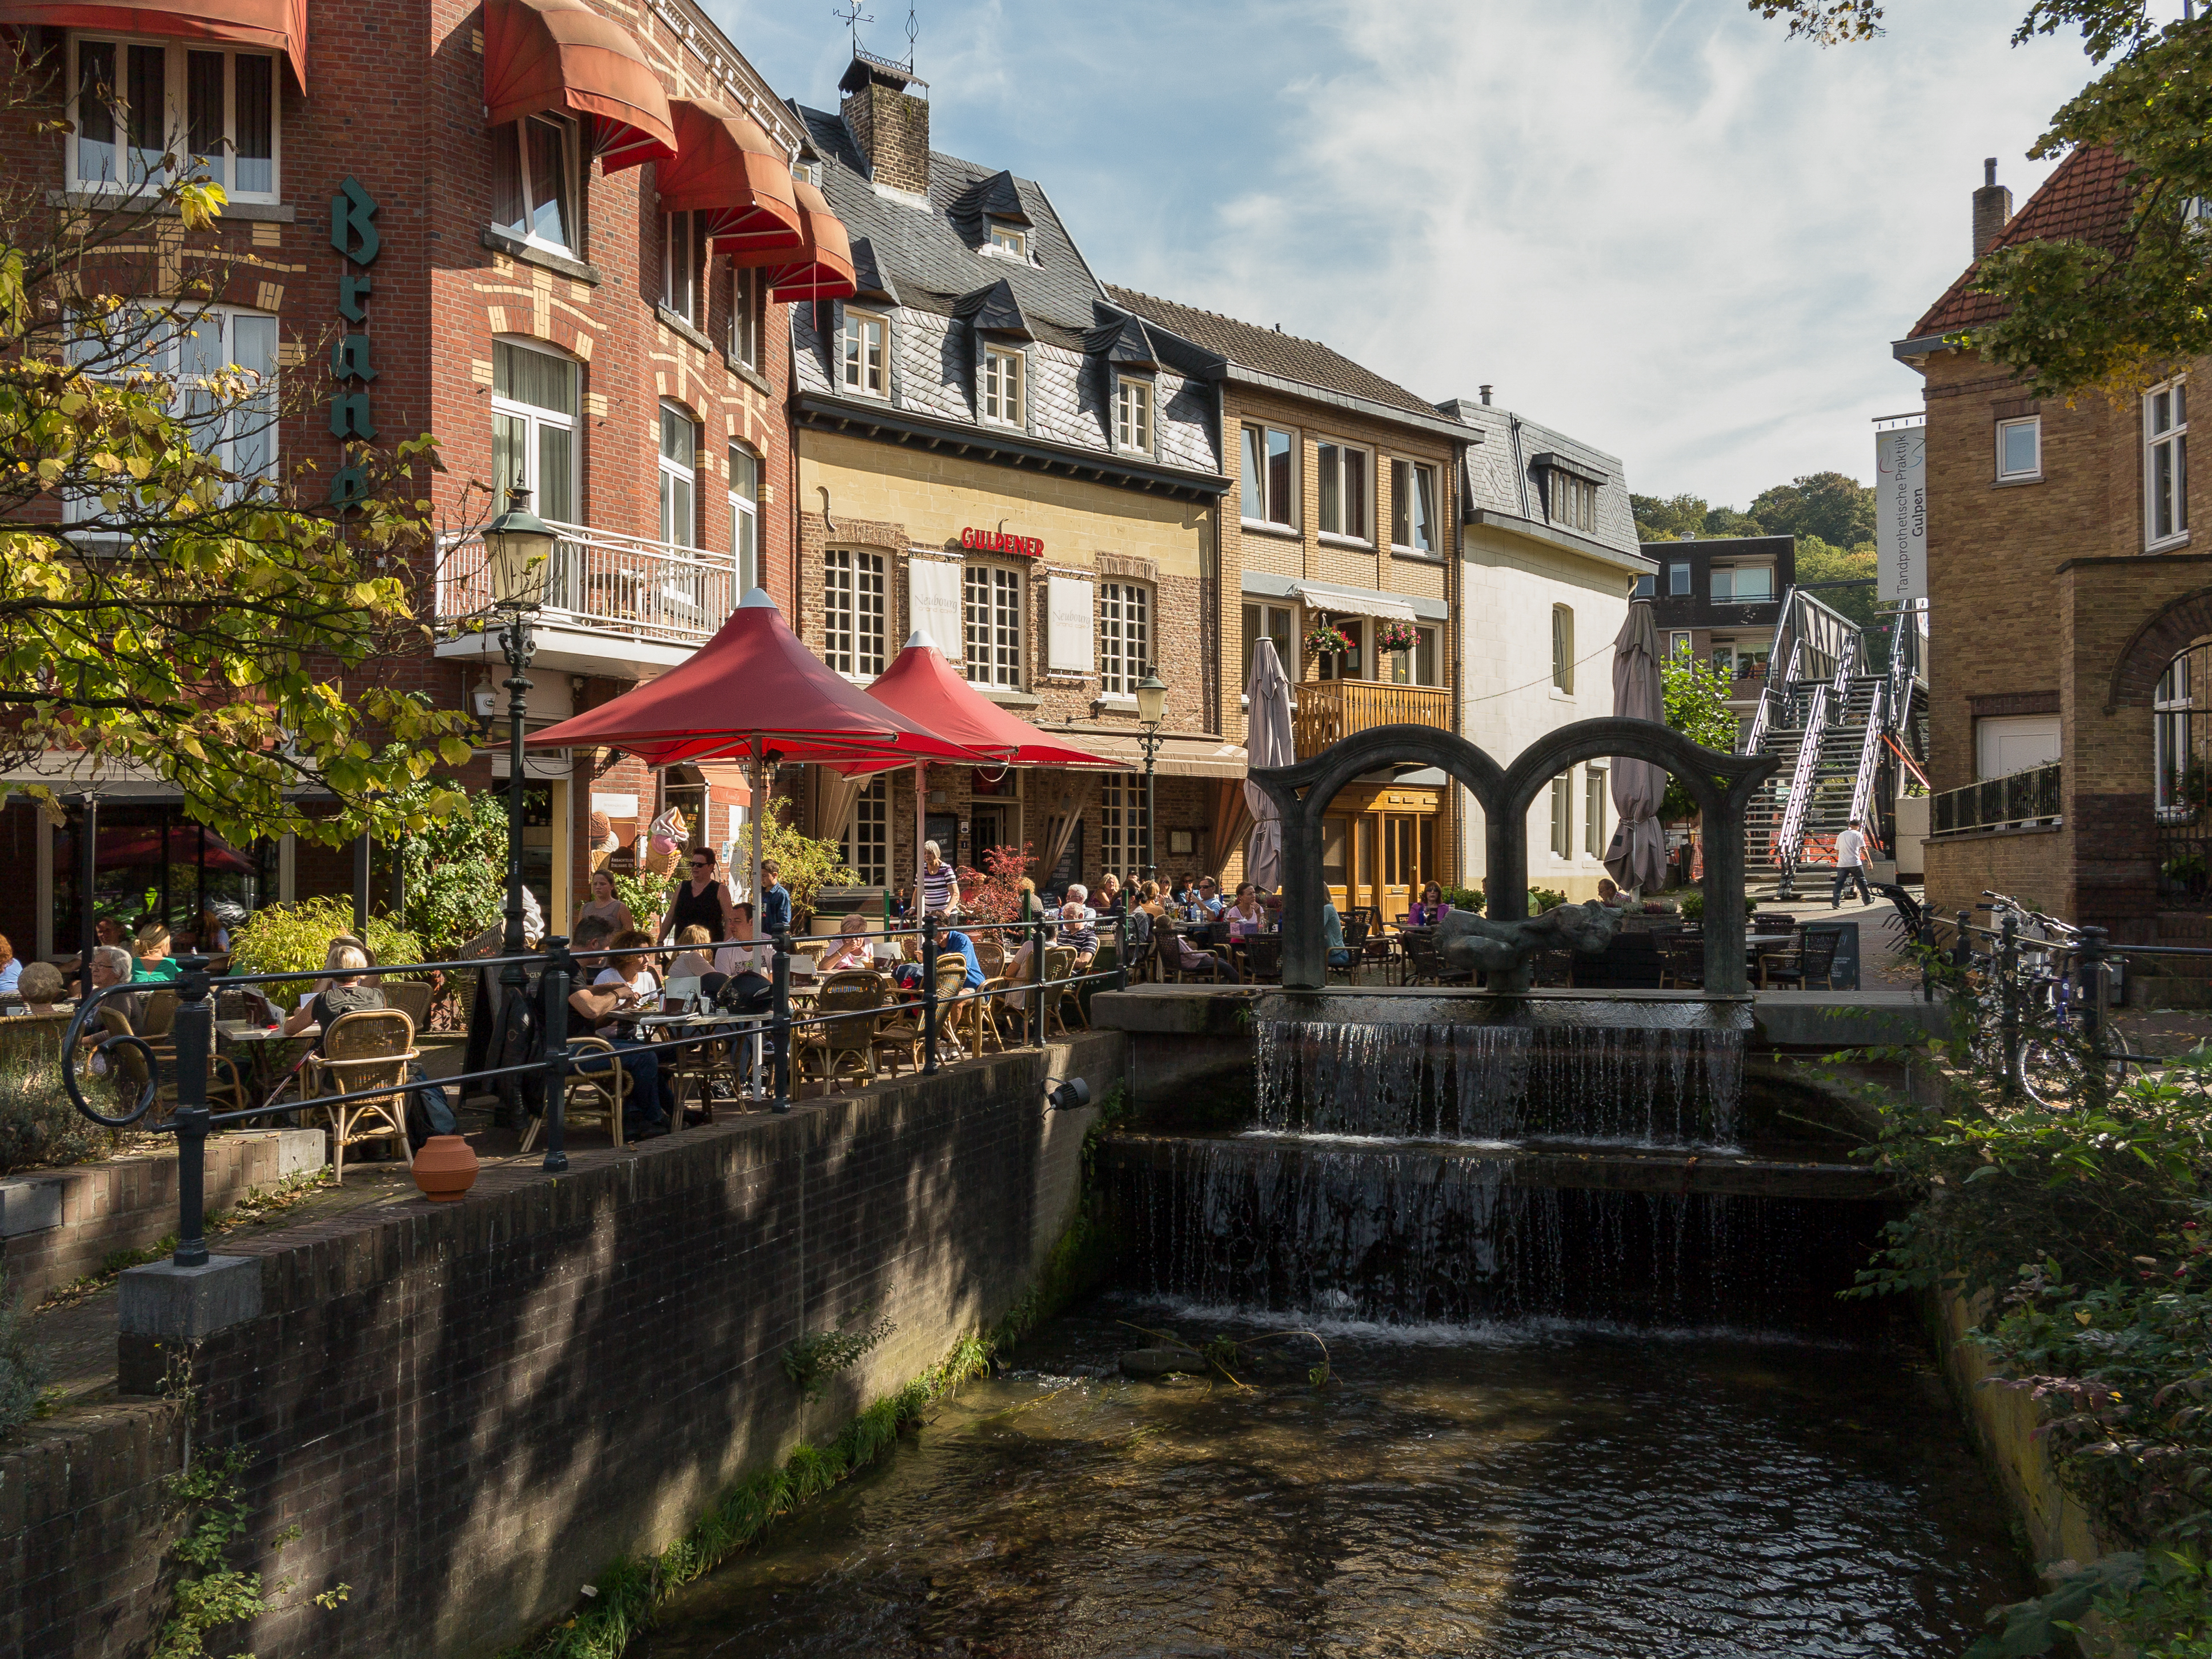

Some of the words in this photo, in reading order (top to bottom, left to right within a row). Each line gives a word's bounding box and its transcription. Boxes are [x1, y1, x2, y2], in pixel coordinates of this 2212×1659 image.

[329, 175, 379, 512] Brand
[1895, 434, 1909, 482] Praktijk
[1912, 487, 1926, 538] Gulpen
[961, 527, 1044, 558] GULPENER
[1896, 483, 1910, 594] Tandprothetische
[914, 593, 957, 614] Neubourg
[1052, 610, 1090, 628] Neubourg
